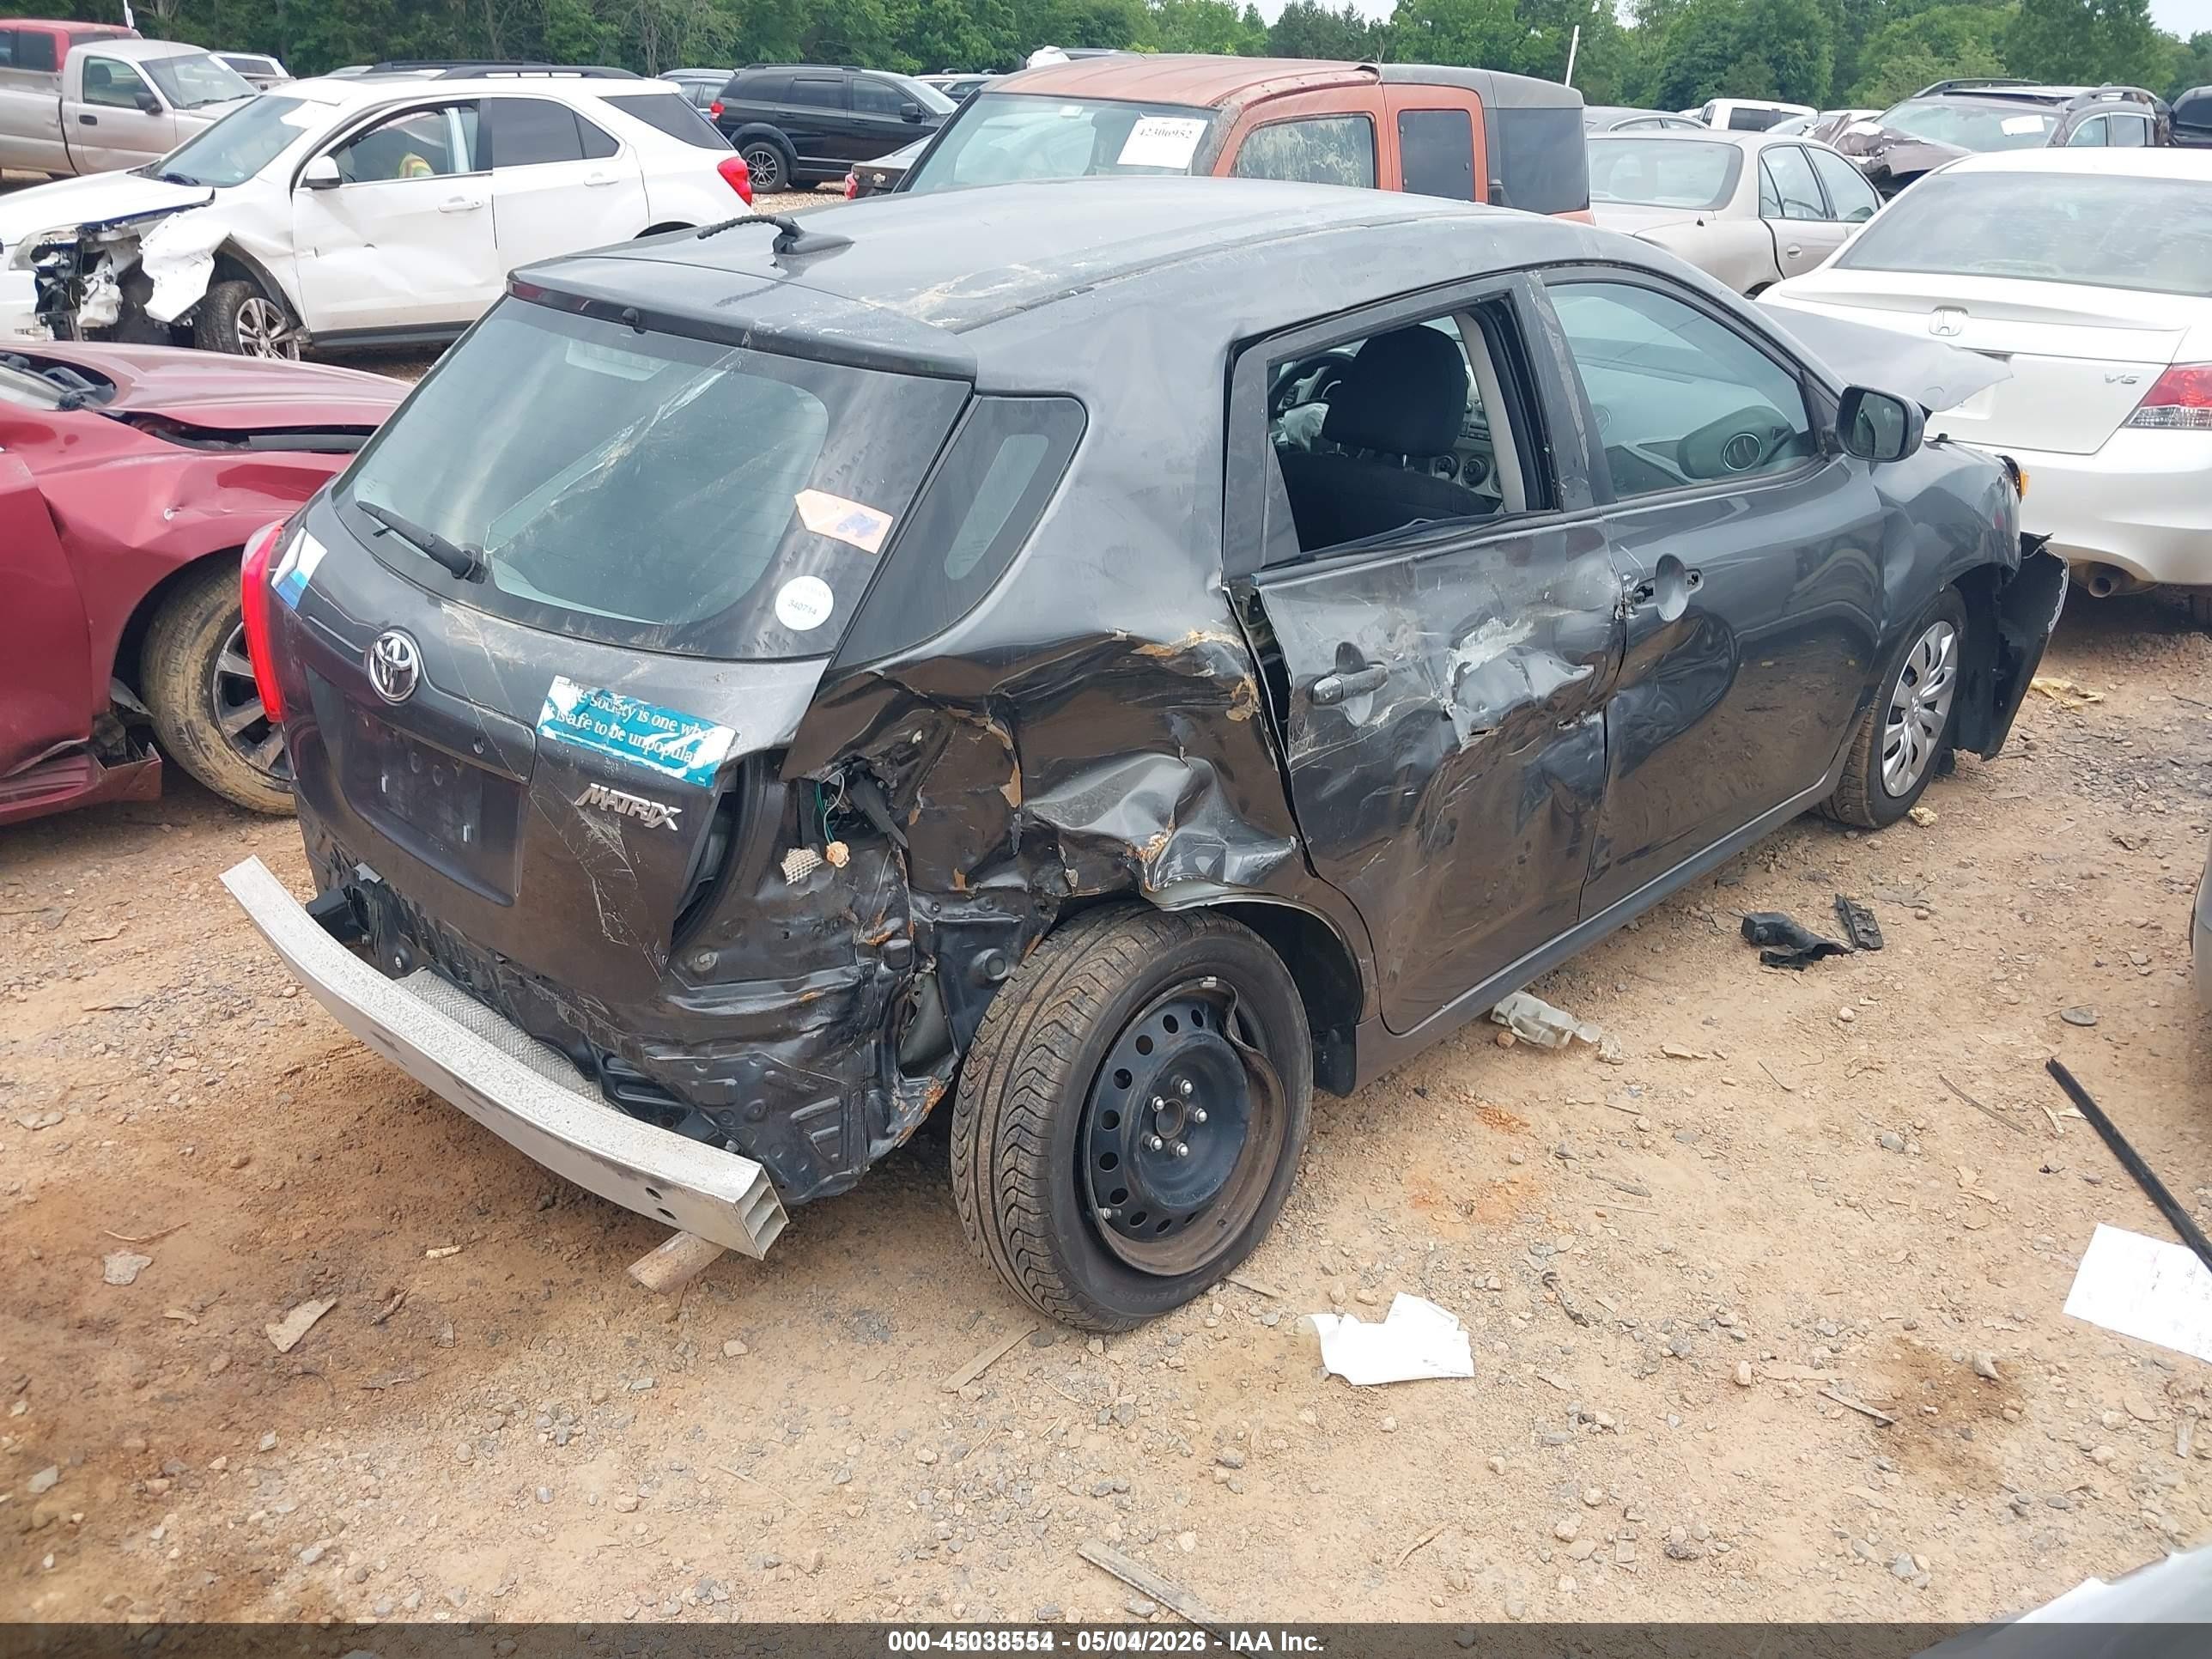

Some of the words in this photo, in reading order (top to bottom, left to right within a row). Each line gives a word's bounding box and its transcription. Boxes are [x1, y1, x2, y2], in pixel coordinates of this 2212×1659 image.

[2104, 371, 2140, 385] V6
[594, 720, 608, 736] to
[608, 723, 627, 742] be
[636, 706, 650, 723] is
[651, 714, 678, 732] one
[574, 782, 683, 831] MATRIX
